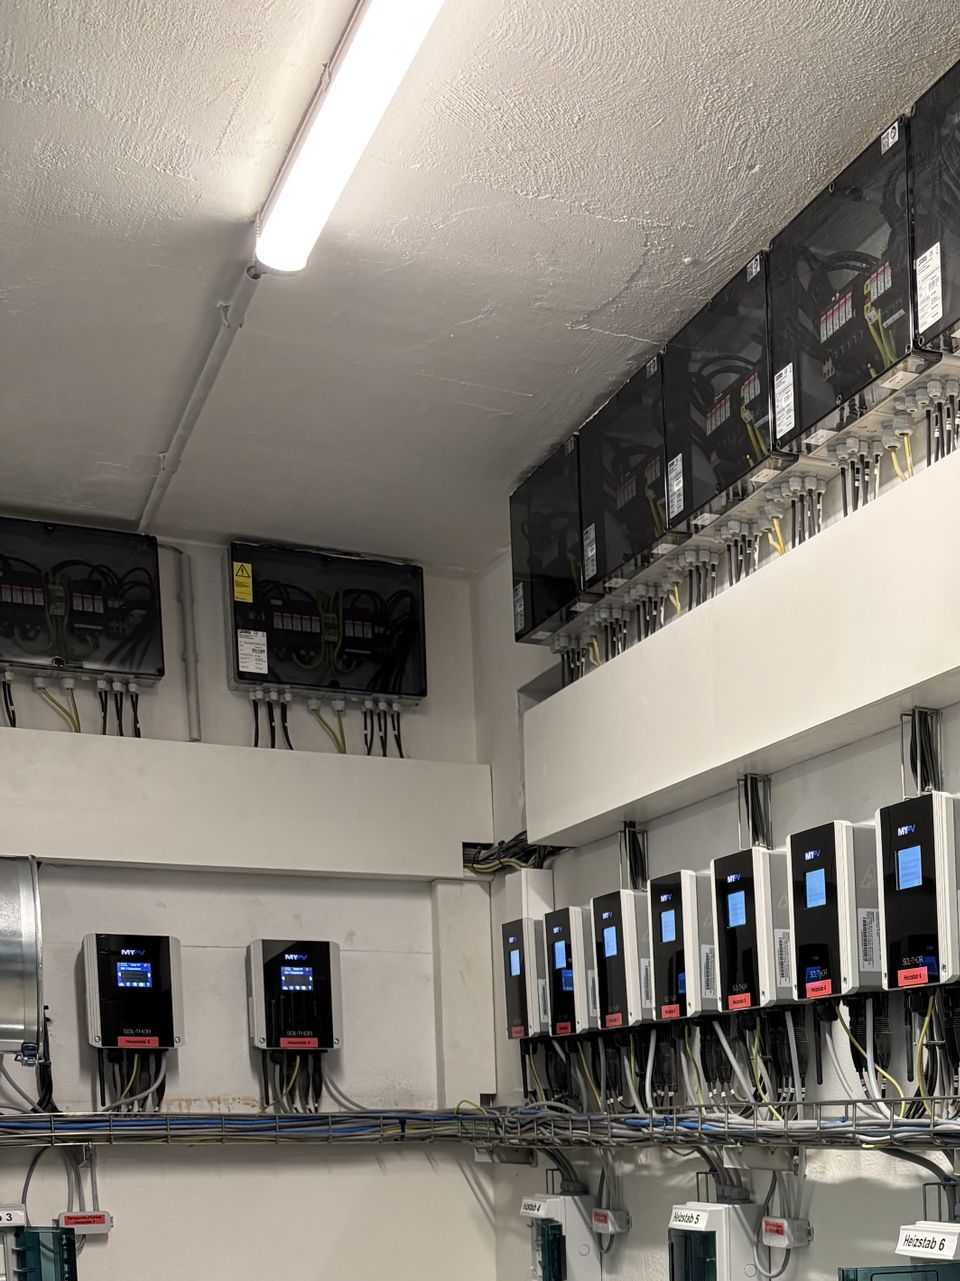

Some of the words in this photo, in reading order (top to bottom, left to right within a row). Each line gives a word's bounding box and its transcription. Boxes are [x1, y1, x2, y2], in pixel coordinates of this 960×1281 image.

[5, 1212, 13, 1222] 3
[694, 1213, 700, 1225] 5
[903, 1233, 937, 1250] Heizstab
[938, 1237, 946, 1251] 6
